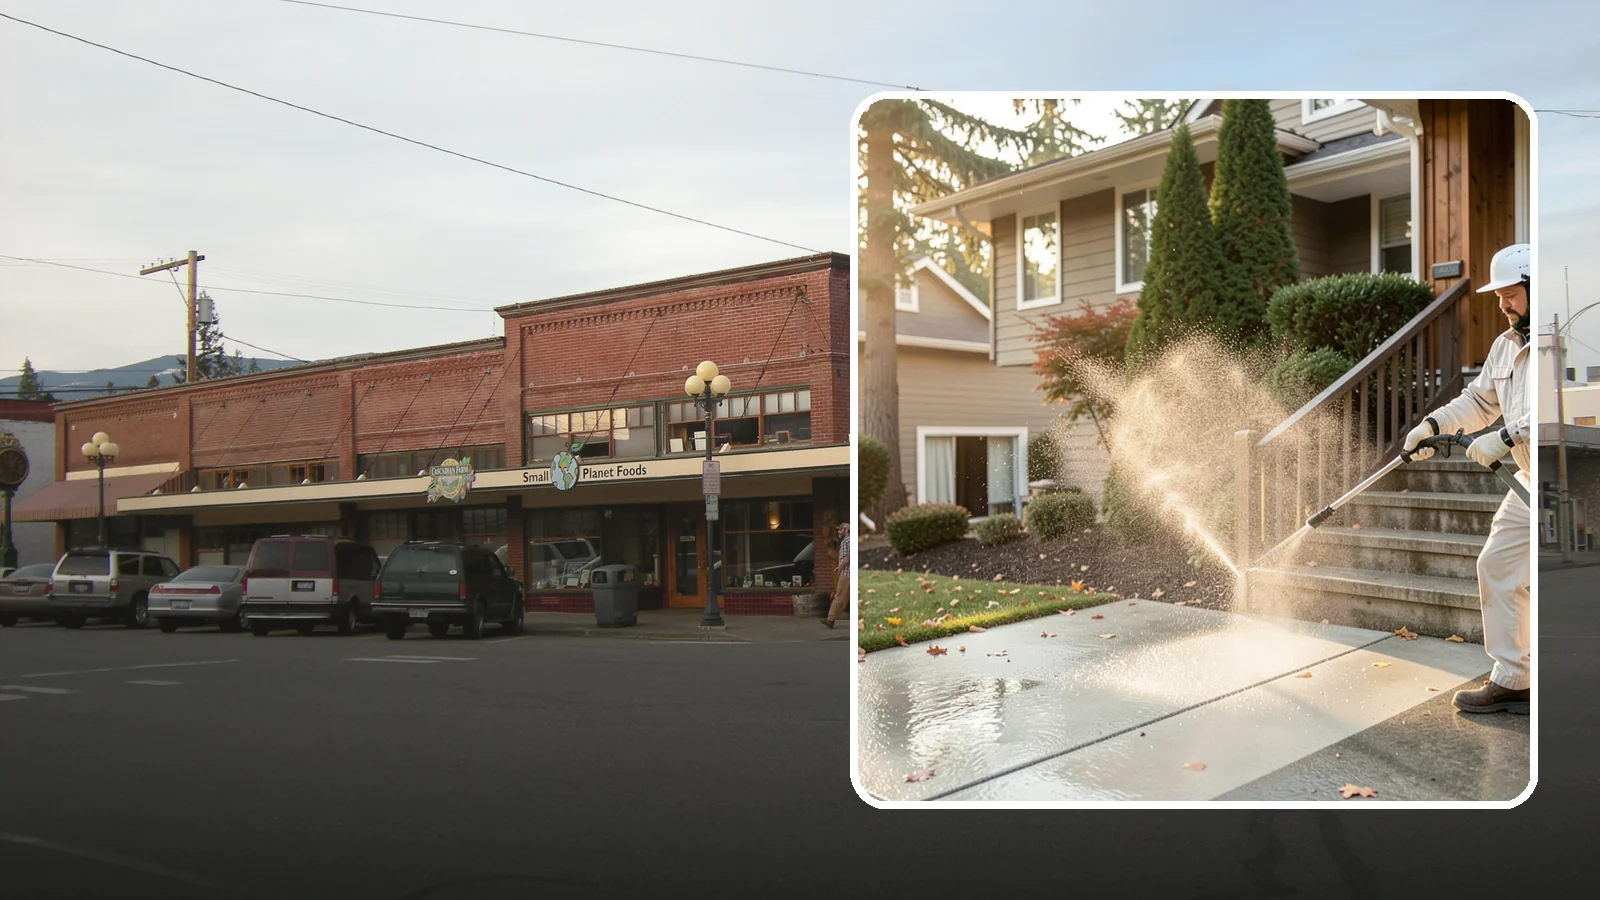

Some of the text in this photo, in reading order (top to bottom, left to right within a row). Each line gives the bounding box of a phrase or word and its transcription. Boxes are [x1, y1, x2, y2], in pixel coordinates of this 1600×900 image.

[523, 464, 647, 483] Small Planet Foods
